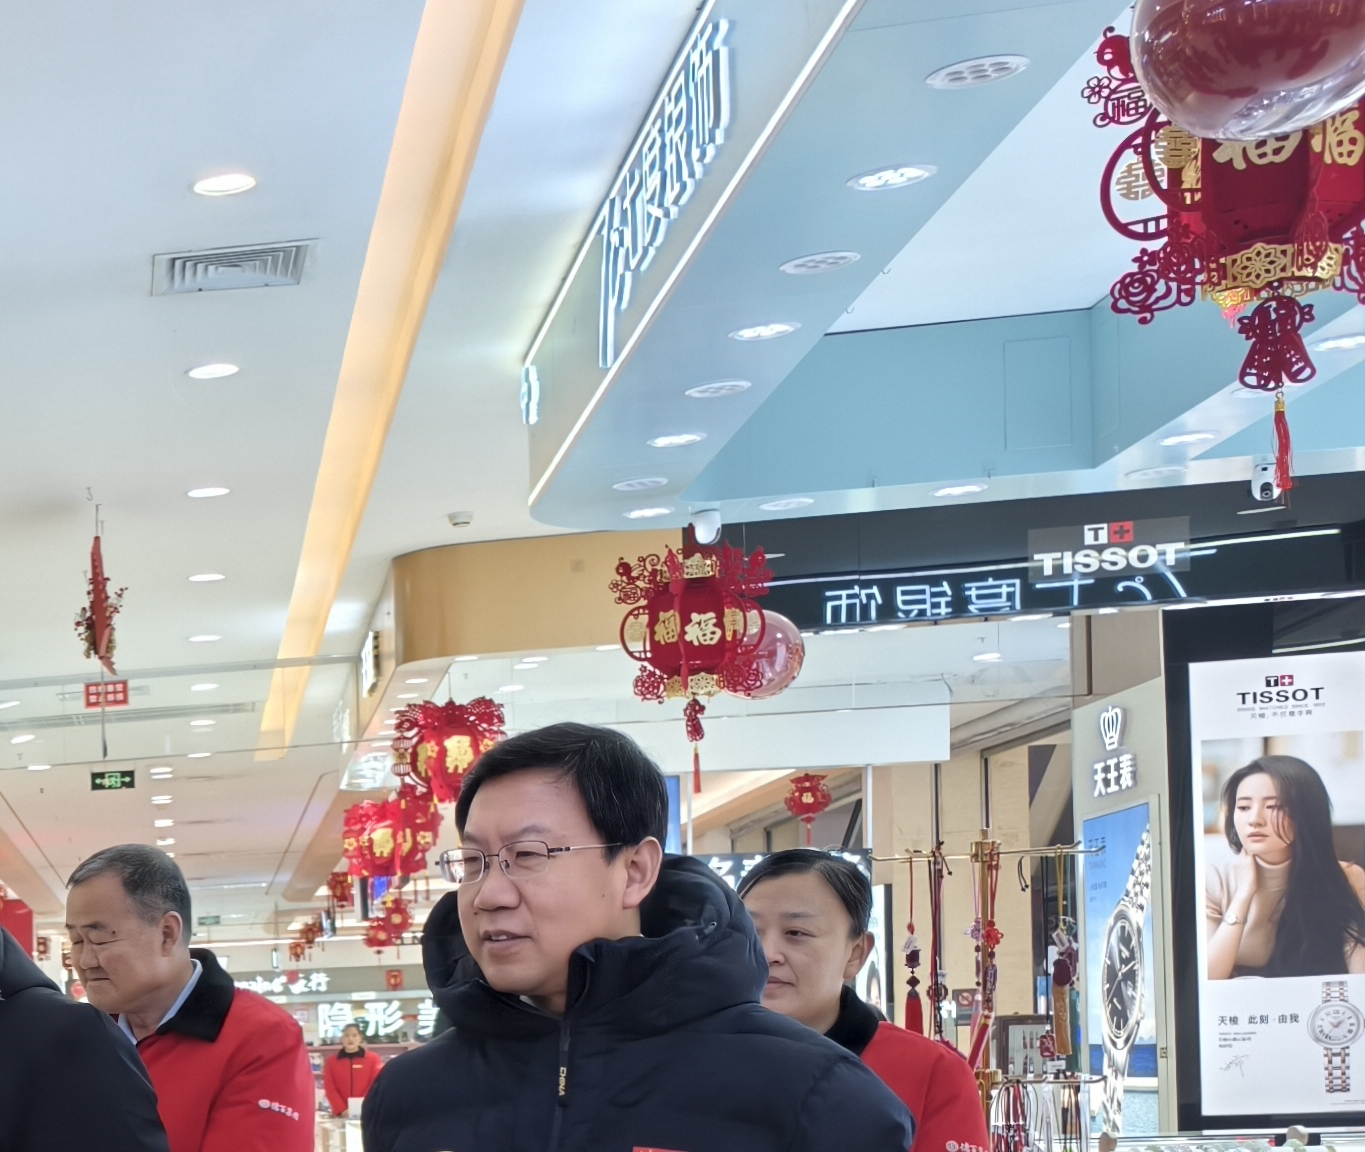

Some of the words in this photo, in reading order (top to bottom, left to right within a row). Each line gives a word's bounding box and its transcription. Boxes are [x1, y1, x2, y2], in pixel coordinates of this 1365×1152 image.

[1033, 542, 1186, 576] TISSOT
[684, 612, 722, 646] 福
[1236, 687, 1325, 705] TISSOT
[1093, 753, 1135, 797] 天王表
[1217, 1015, 1239, 1026] 天梭
